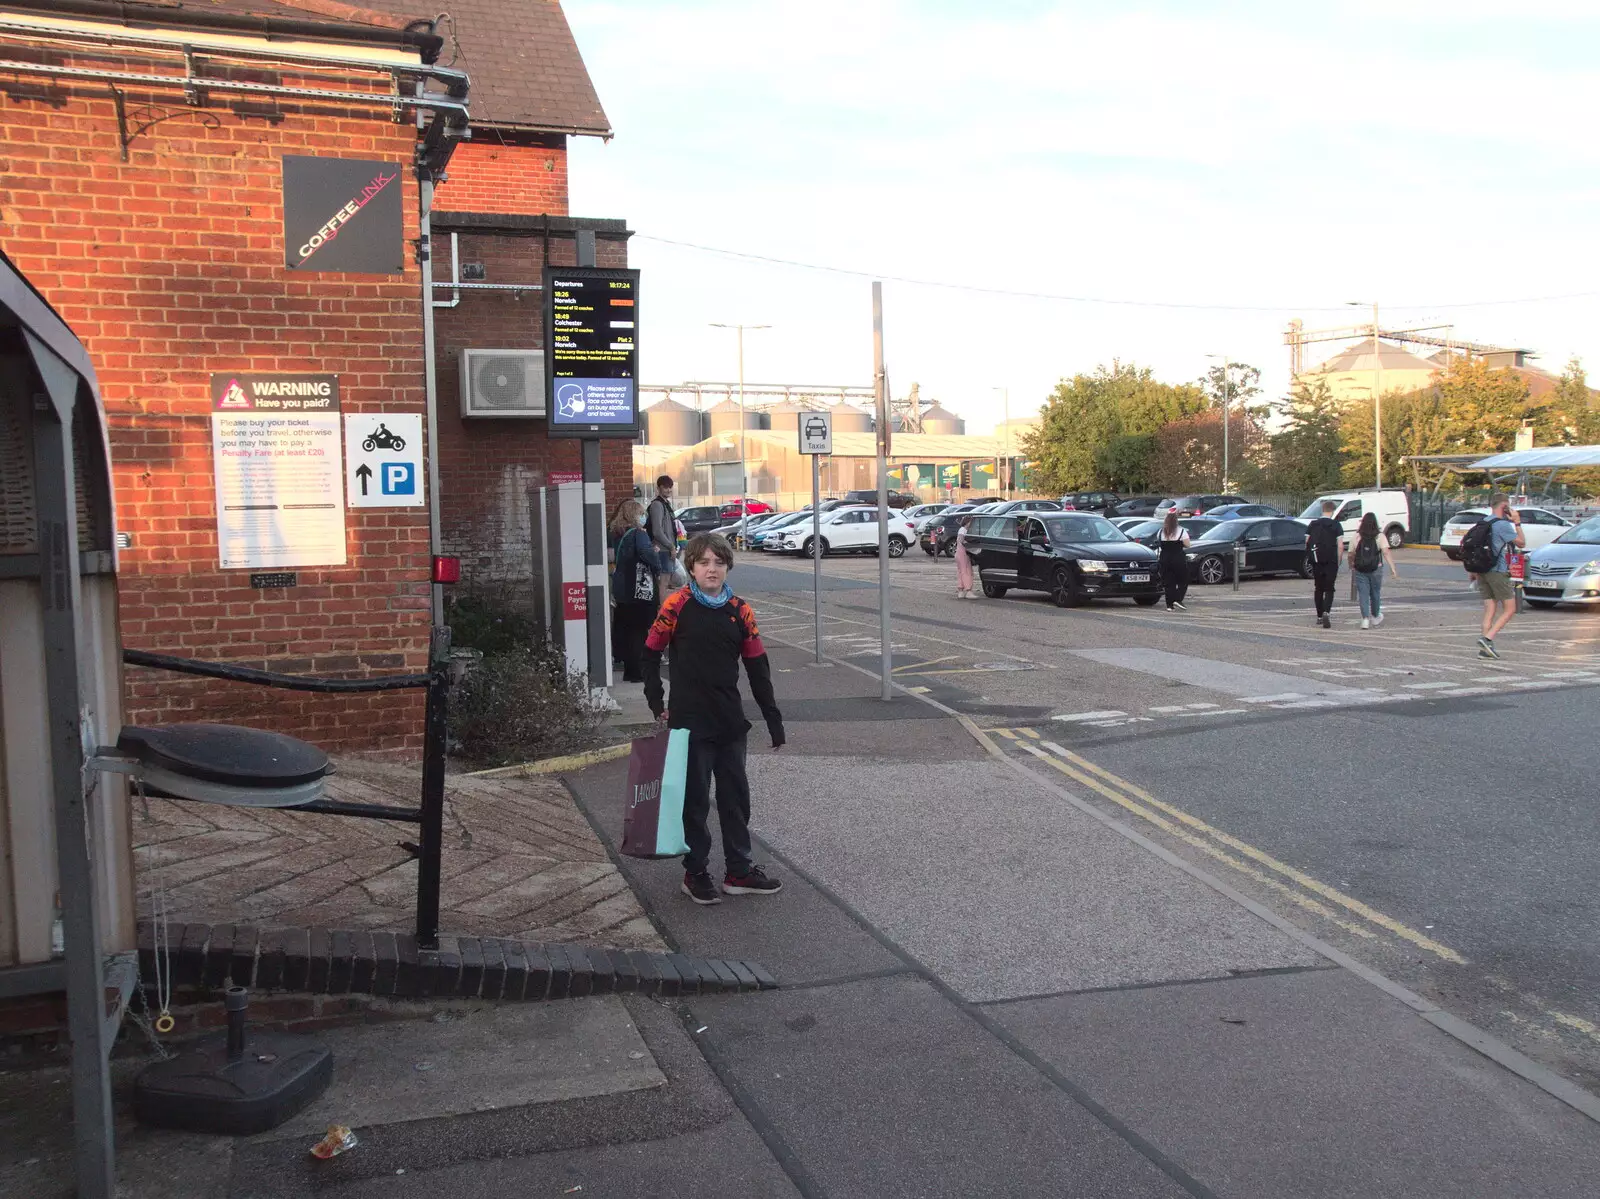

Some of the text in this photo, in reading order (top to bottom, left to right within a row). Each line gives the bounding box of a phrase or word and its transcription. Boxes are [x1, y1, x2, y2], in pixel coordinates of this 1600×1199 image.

[252, 382, 331, 396] WARNING
[255, 398, 280, 408] Have
[282, 400, 300, 410] you
[303, 398, 330, 410] paid?
[250, 420, 264, 428] buy
[290, 440, 305, 448] pay
[222, 449, 252, 458] Penalty
[274, 448, 284, 457] (at
[308, 448, 324, 457] £20)
[388, 466, 408, 492] P
